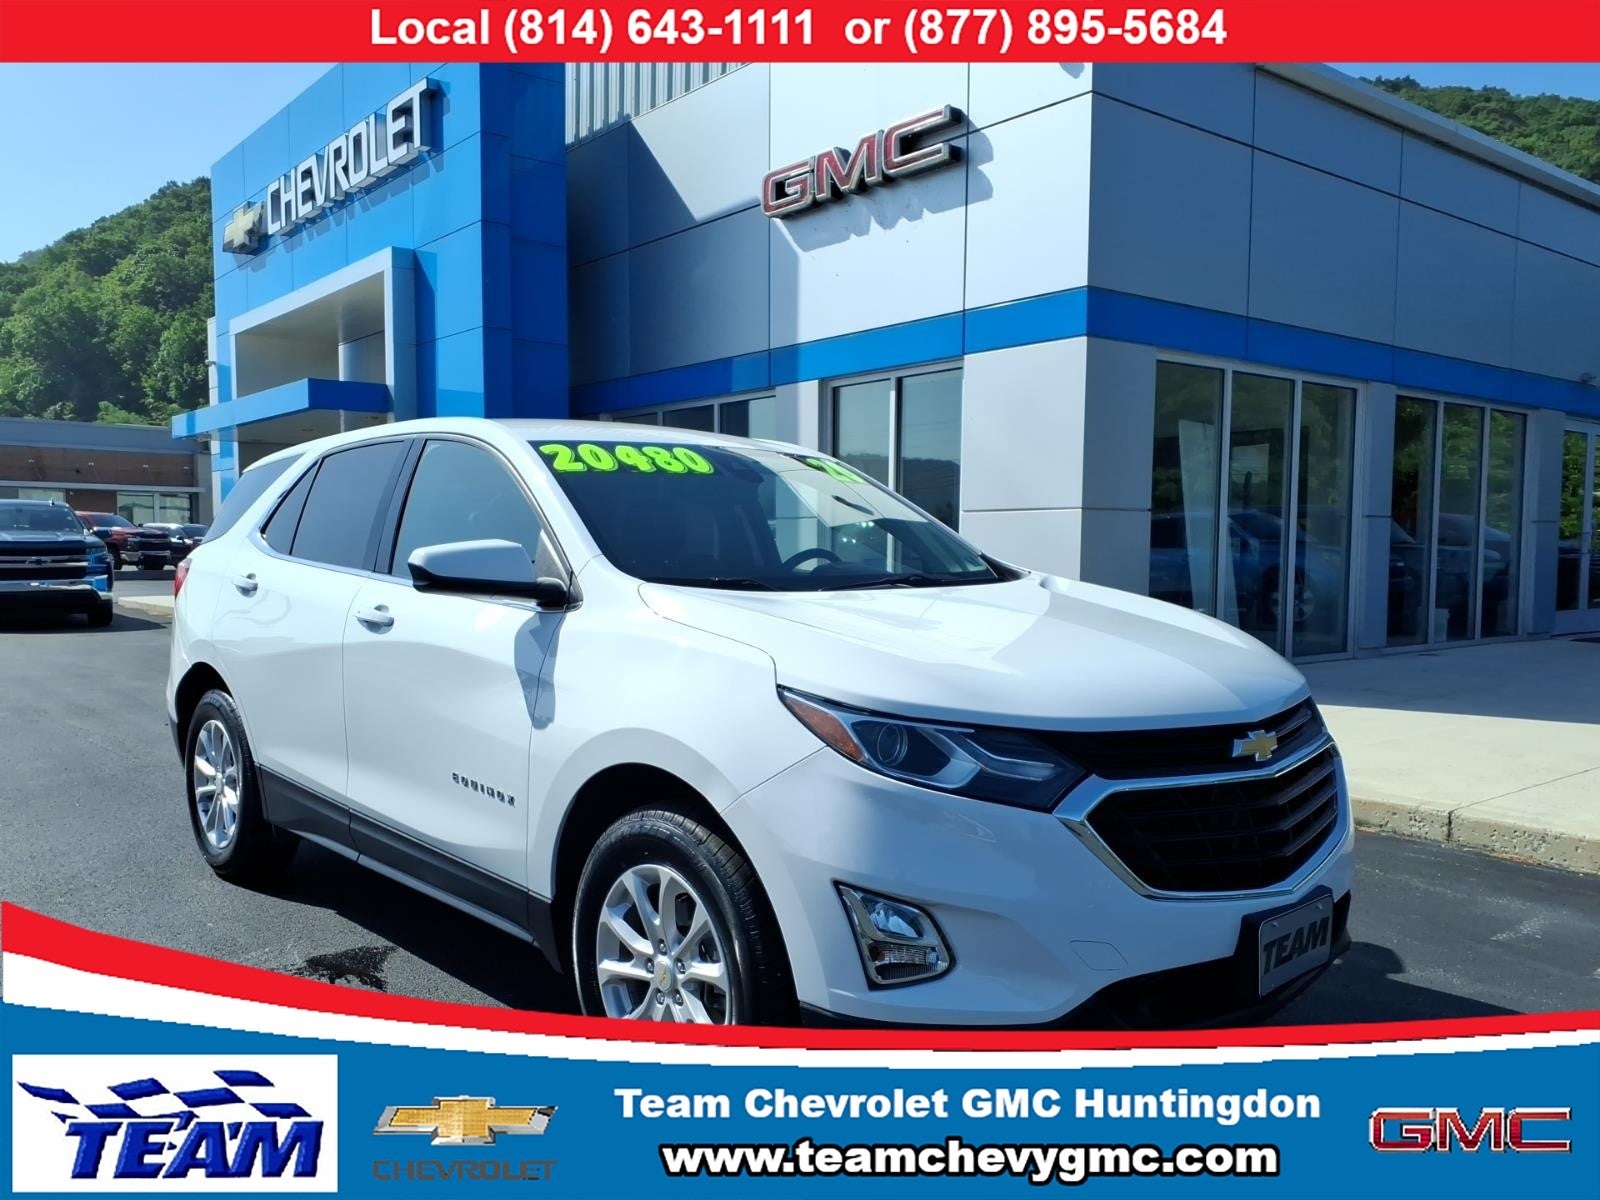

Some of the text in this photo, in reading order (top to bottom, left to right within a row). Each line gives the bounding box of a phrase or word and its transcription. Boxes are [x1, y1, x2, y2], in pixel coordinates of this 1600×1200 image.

[266, 76, 434, 235] CHEVROLET
[761, 104, 964, 218] GMC
[538, 443, 714, 475] 20480
[451, 771, 516, 809] EQUINOX
[1262, 915, 1331, 976] TEAM
